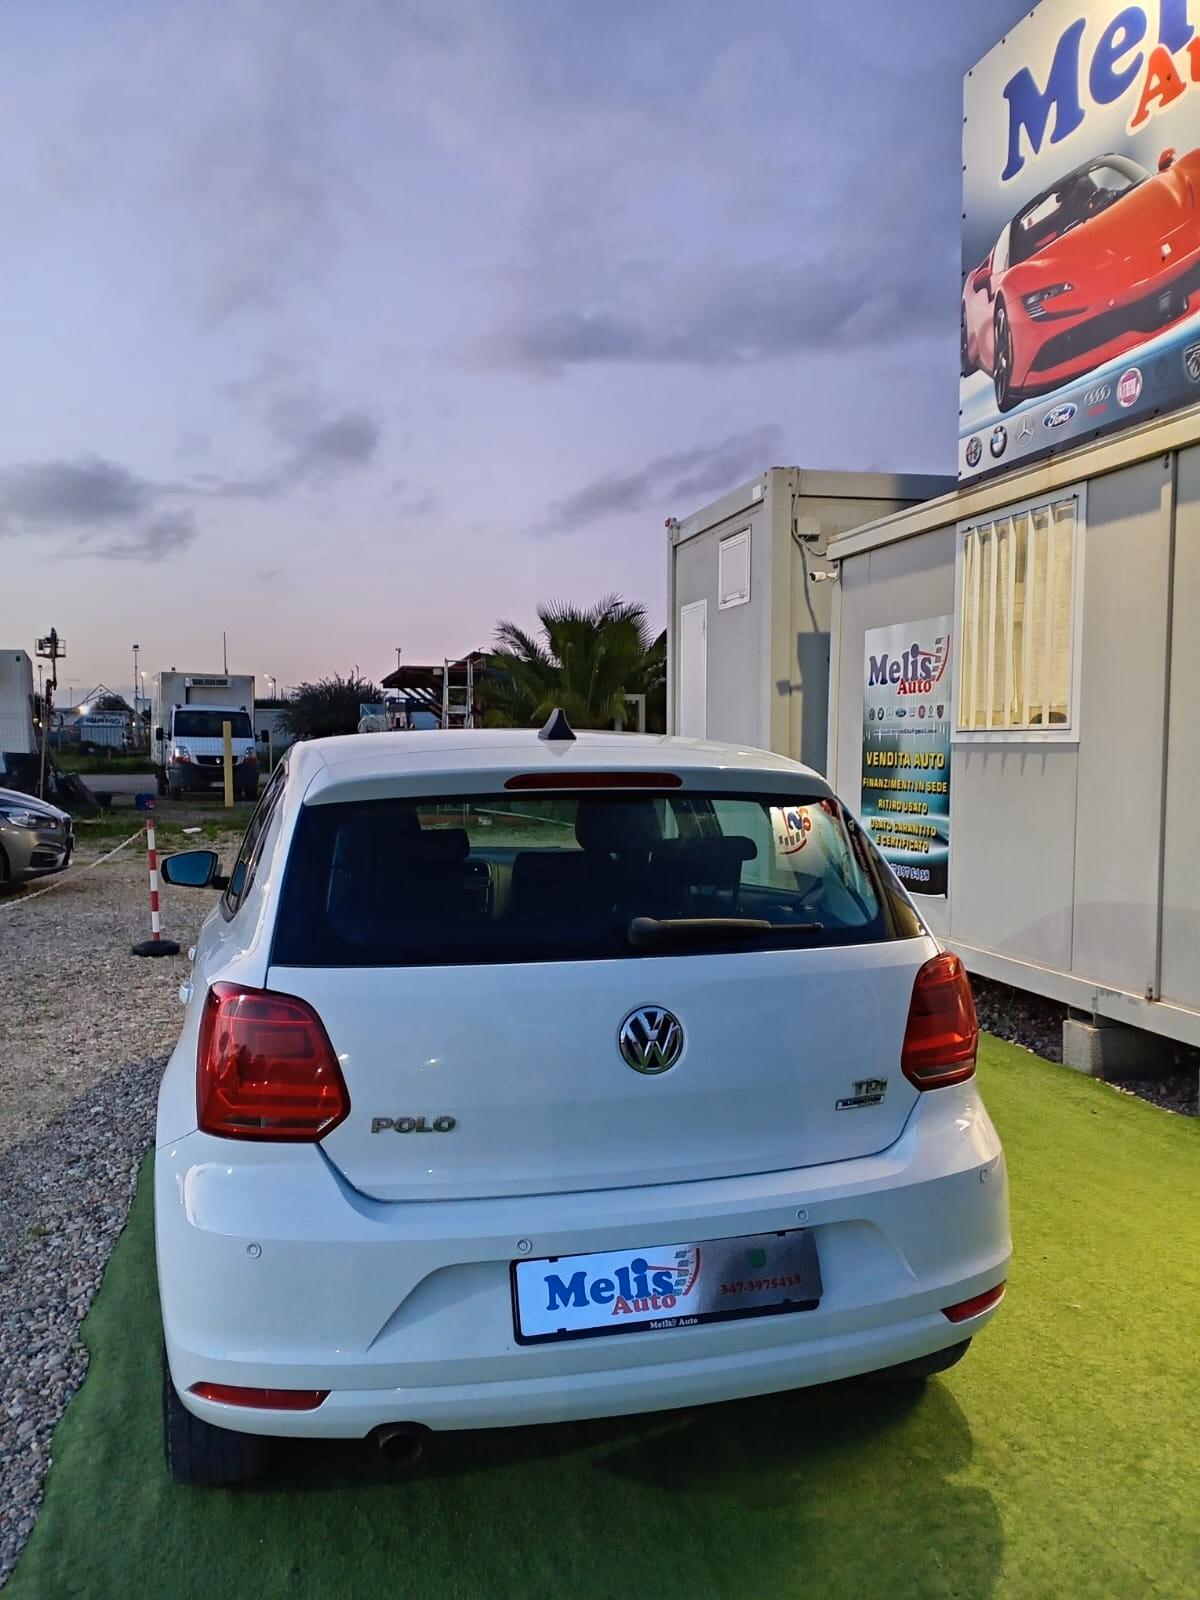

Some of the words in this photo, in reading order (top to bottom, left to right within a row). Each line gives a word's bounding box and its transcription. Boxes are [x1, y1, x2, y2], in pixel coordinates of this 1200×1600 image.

[868, 643, 932, 686] Melis
[897, 678, 932, 695] Auto
[866, 752, 911, 768] VENDITA
[914, 752, 945, 769] AUTO
[927, 781, 948, 794] SEDE
[878, 799, 902, 812] RITIRO
[902, 801, 928, 815] USATO
[870, 818, 893, 832] USATO
[894, 823, 937, 838] GARANTITO
[882, 835, 929, 854] CERTIFICATO
[852, 1078, 888, 1096] TDI
[371, 1115, 456, 1133] POLO
[544, 1258, 674, 1311] Melis
[611, 1291, 677, 1315] Auto
[679, 1317, 698, 1326] Auto
